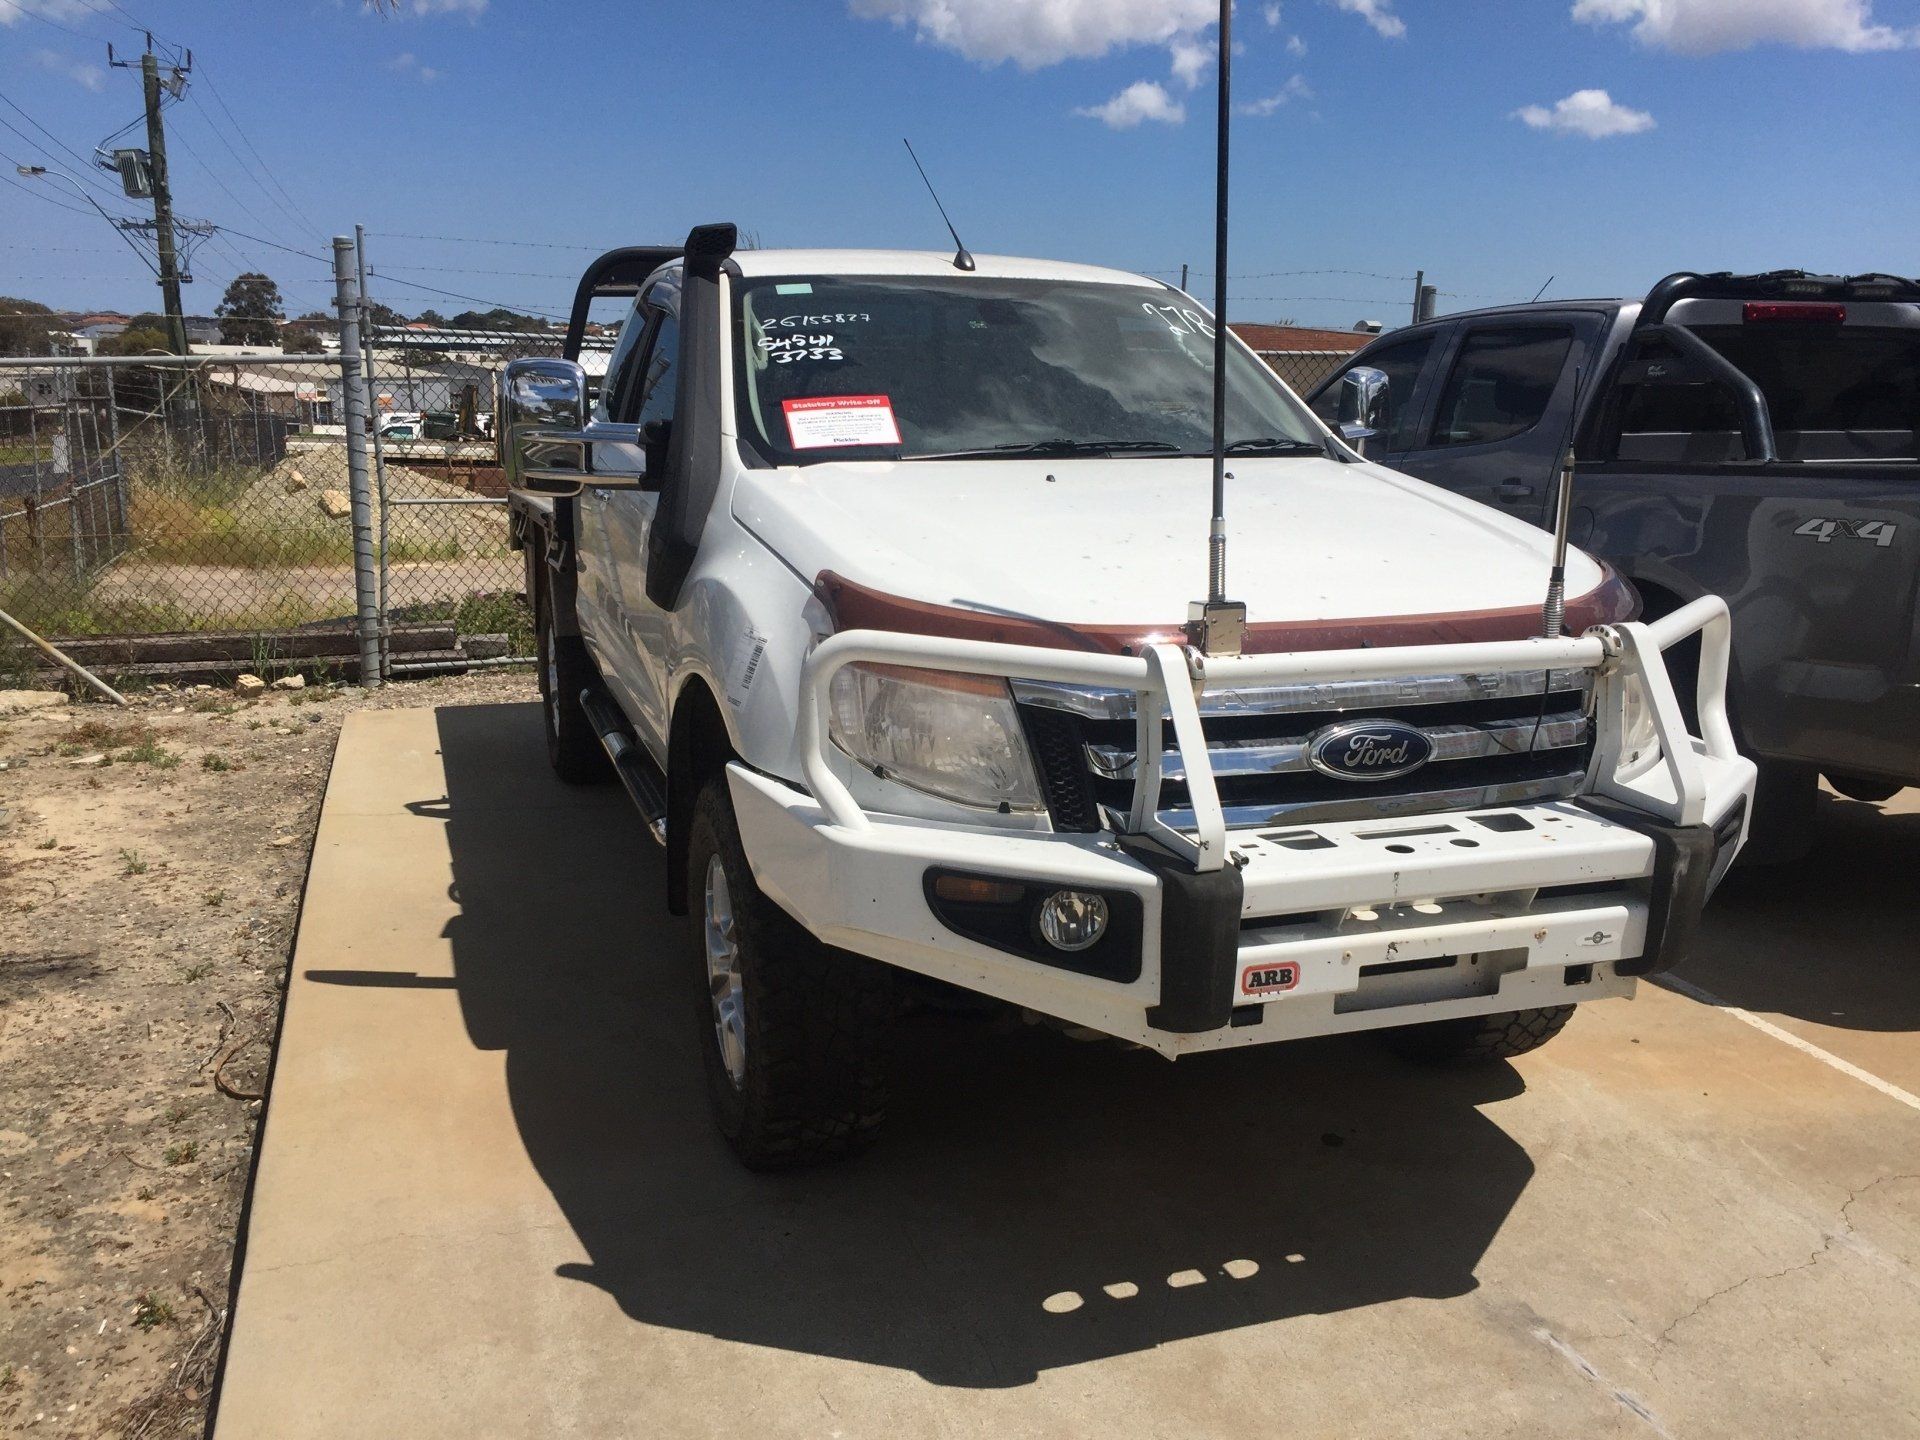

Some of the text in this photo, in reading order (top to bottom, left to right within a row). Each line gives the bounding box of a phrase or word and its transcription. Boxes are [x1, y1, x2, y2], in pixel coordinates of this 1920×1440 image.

[771, 347, 845, 364] 3733
[791, 398, 881, 410] Statutory Write-Off
[1344, 734, 1408, 767] Ford
[1249, 968, 1293, 988] ARB
